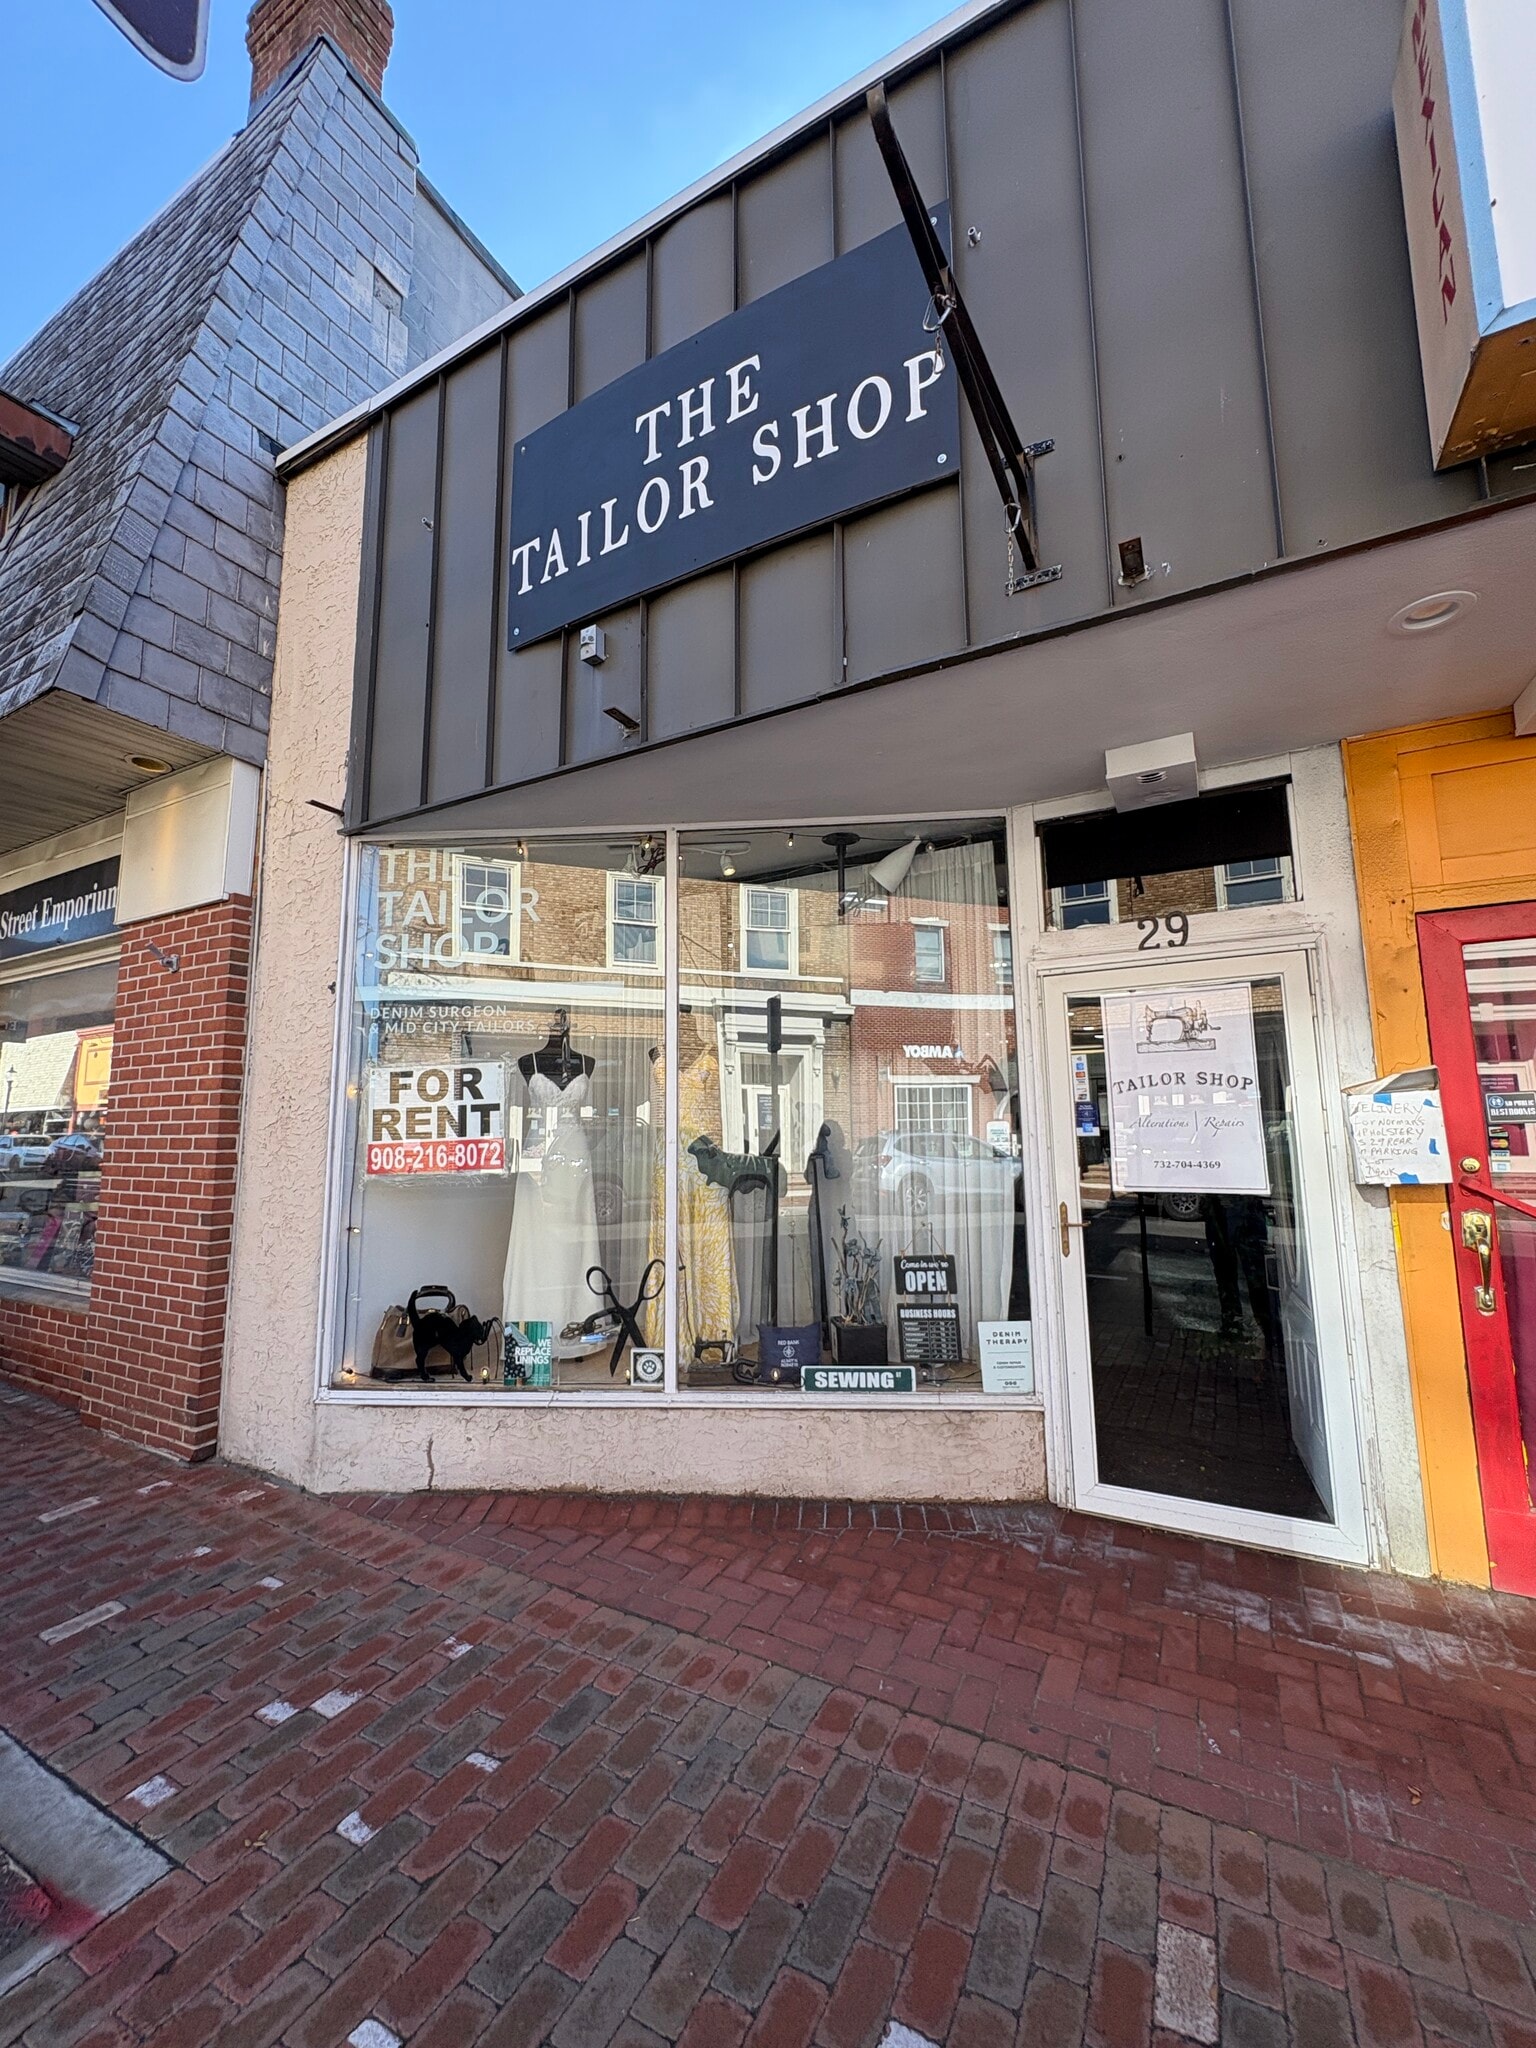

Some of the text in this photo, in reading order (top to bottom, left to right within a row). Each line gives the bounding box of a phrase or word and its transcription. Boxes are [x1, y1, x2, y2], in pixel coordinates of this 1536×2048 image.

[635, 354, 761, 465] THE
[511, 350, 944, 595] TAILOR SHOP
[378, 848, 465, 884] THE
[377, 887, 541, 928] TAILOR
[0, 904, 38, 940] Street
[1138, 911, 1189, 950] 29
[373, 931, 500, 970] SHOP
[370, 1005, 508, 1020] DENIM SURGEON
[385, 1022, 417, 1034] MID
[422, 1021, 459, 1033] CITY
[465, 1020, 535, 1033] TAILORS
[388, 1067, 485, 1104] FOR
[1113, 1072, 1254, 1094] TAILOR SHOP
[372, 1103, 500, 1142] RENT
[1129, 1114, 1245, 1137] Alterations Repairs
[370, 1143, 501, 1171] 908-216-8072
[1370, 1147, 1418, 1156] PARKING
[1153, 1160, 1221, 1169] 732-704-4369
[904, 1270, 948, 1292] OPEN
[900, 1308, 956, 1318] BUSINESS HOURS
[515, 1347, 551, 1356] REPLACE
[537, 1338, 552, 1347] WE
[515, 1356, 549, 1364] LININGS
[814, 1371, 895, 1389] SEWING
